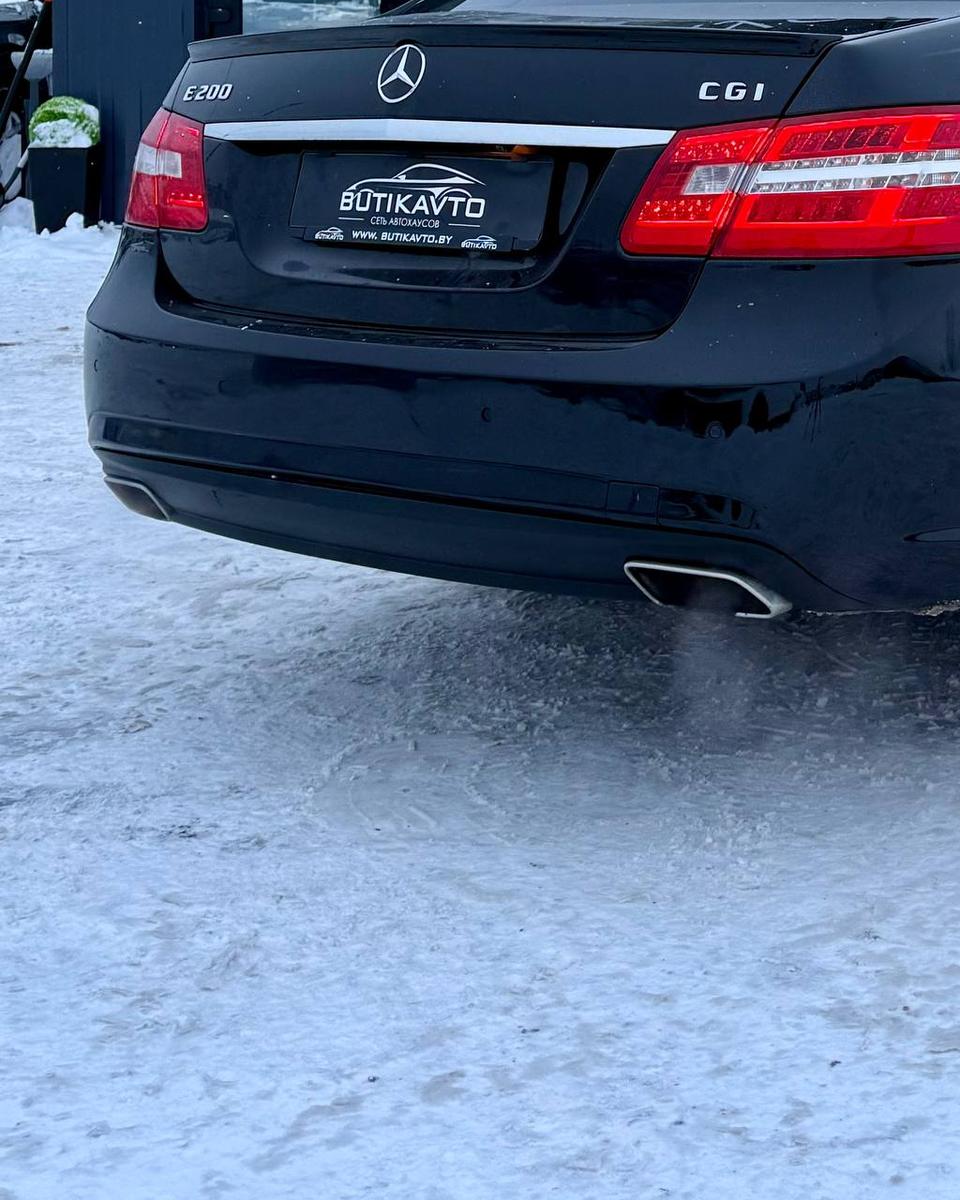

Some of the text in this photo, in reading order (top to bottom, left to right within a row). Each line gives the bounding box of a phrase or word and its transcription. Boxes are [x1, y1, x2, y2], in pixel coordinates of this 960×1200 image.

[183, 84, 233, 102] E200
[698, 82, 765, 101] CGI
[339, 191, 486, 219] BUTIKAVTO
[370, 215, 440, 229] СЕТЬ АВТОХАУСОВ
[352, 230, 453, 245] WWW. BUTIKAVTO.BY
